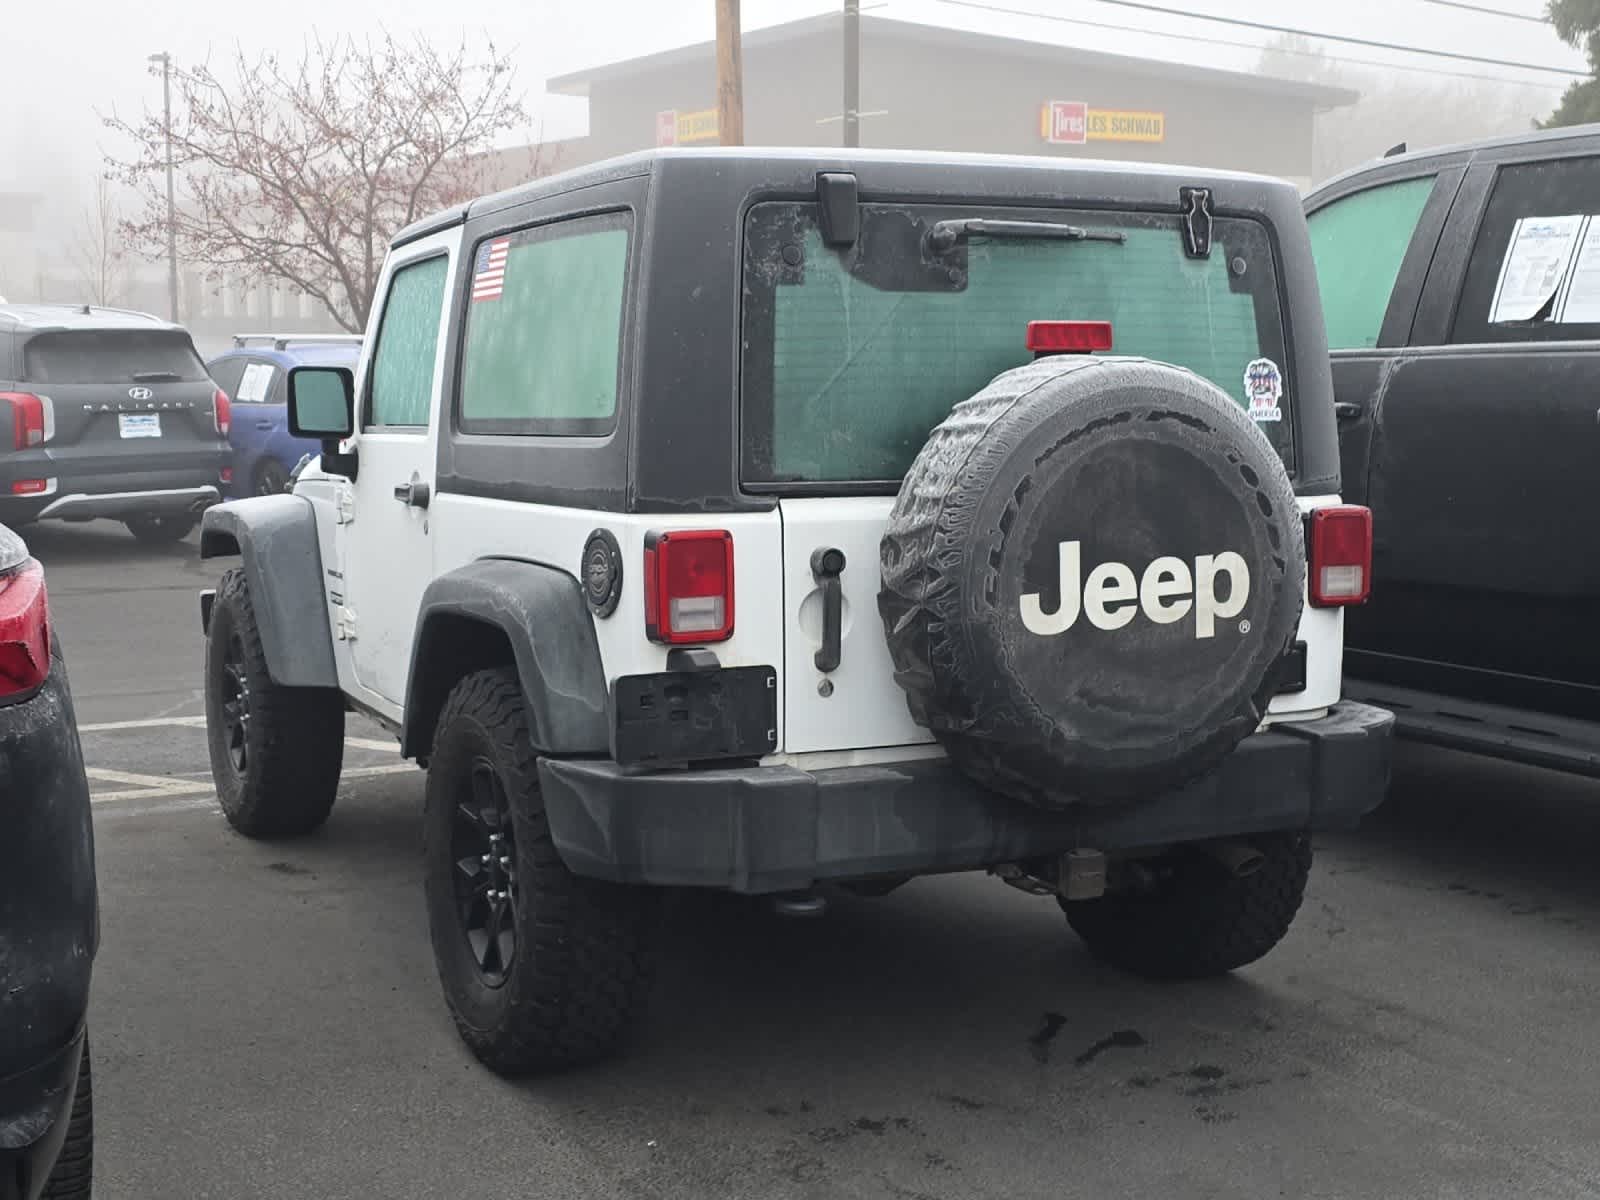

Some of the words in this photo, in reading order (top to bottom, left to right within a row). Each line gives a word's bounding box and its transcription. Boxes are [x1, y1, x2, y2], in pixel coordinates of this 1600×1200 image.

[1055, 106, 1083, 137] Tires
[1088, 116, 1106, 132] LES
[1111, 117, 1161, 137] SCHWAB
[1020, 540, 1250, 639] Jeep
